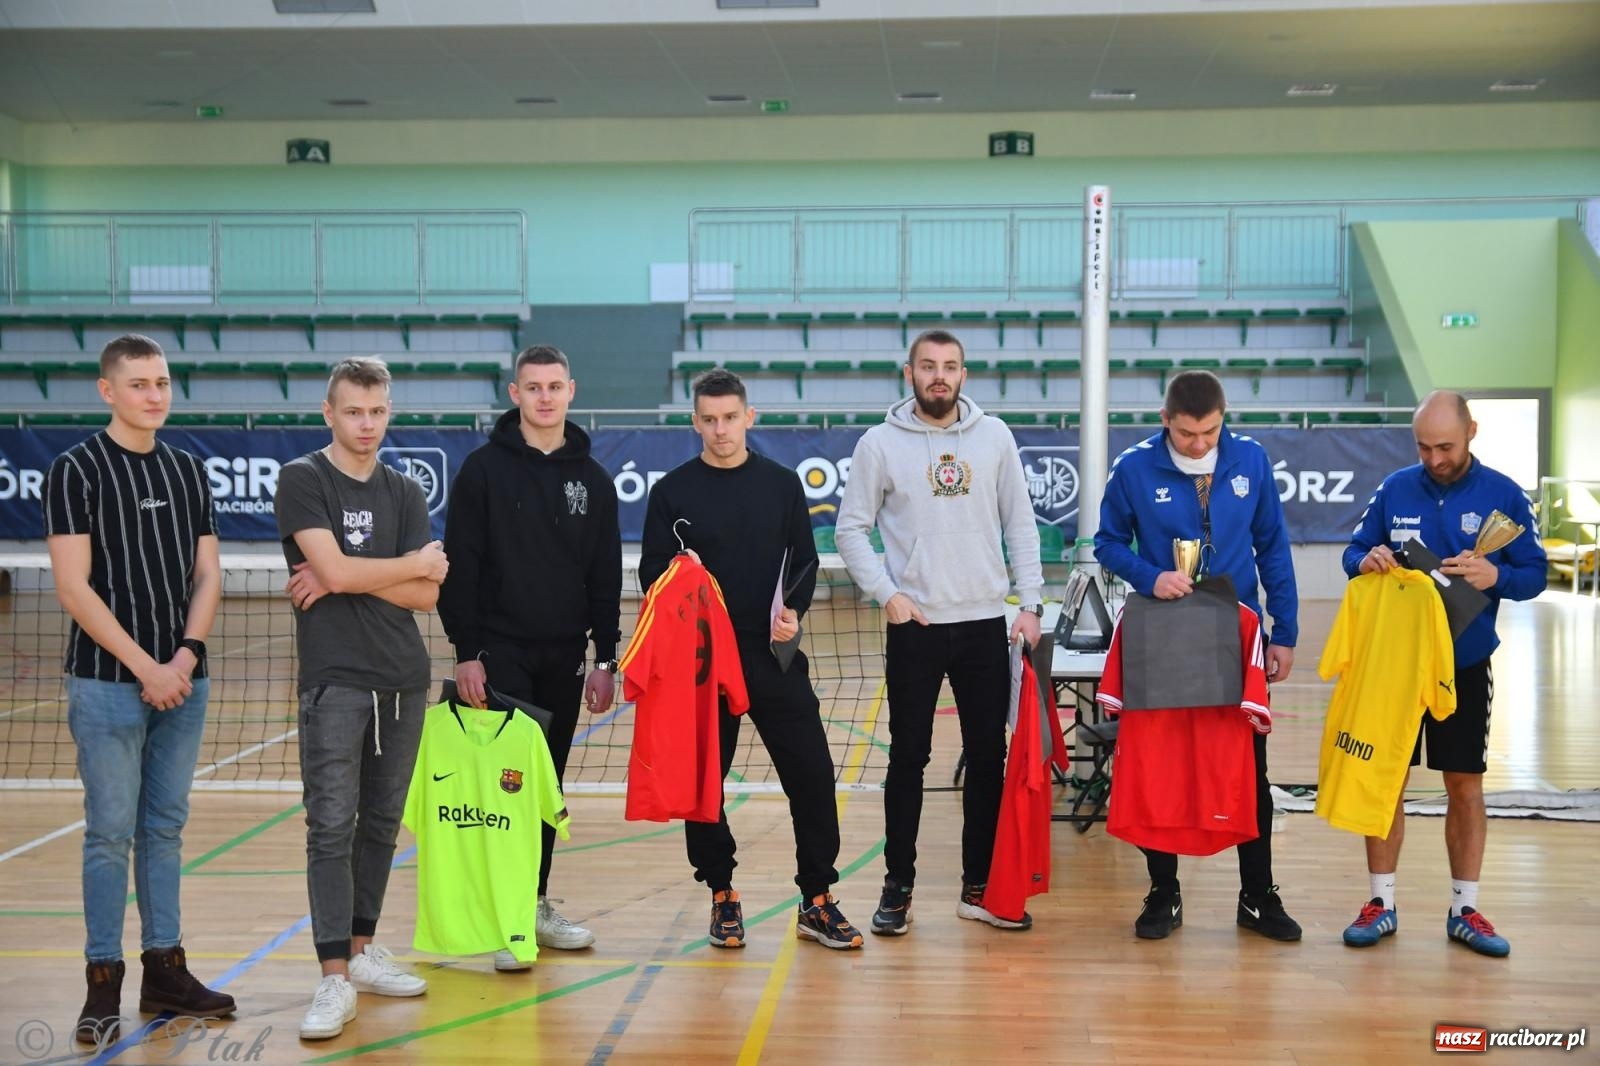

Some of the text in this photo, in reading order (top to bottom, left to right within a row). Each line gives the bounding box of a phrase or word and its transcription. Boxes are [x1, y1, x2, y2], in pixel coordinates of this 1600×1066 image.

[306, 146, 326, 161] A
[1016, 139, 1030, 153] B
[438, 803, 511, 831] Rakuen
